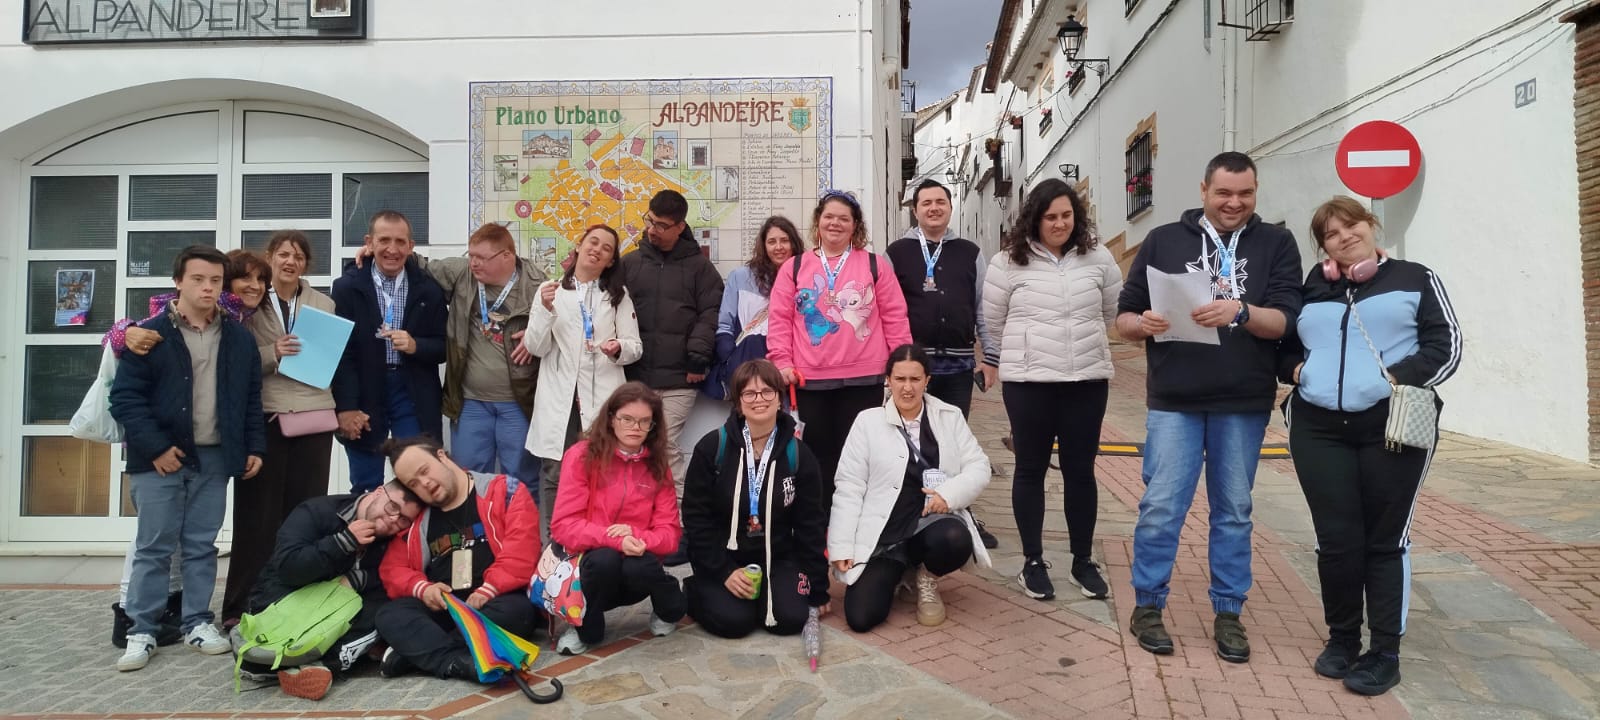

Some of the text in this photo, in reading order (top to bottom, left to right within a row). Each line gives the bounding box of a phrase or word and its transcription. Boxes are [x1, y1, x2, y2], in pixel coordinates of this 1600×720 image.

[27, 0, 299, 33] ALPANDEIRE
[1516, 81, 1536, 105] 20
[495, 105, 621, 126] Plano Urbano
